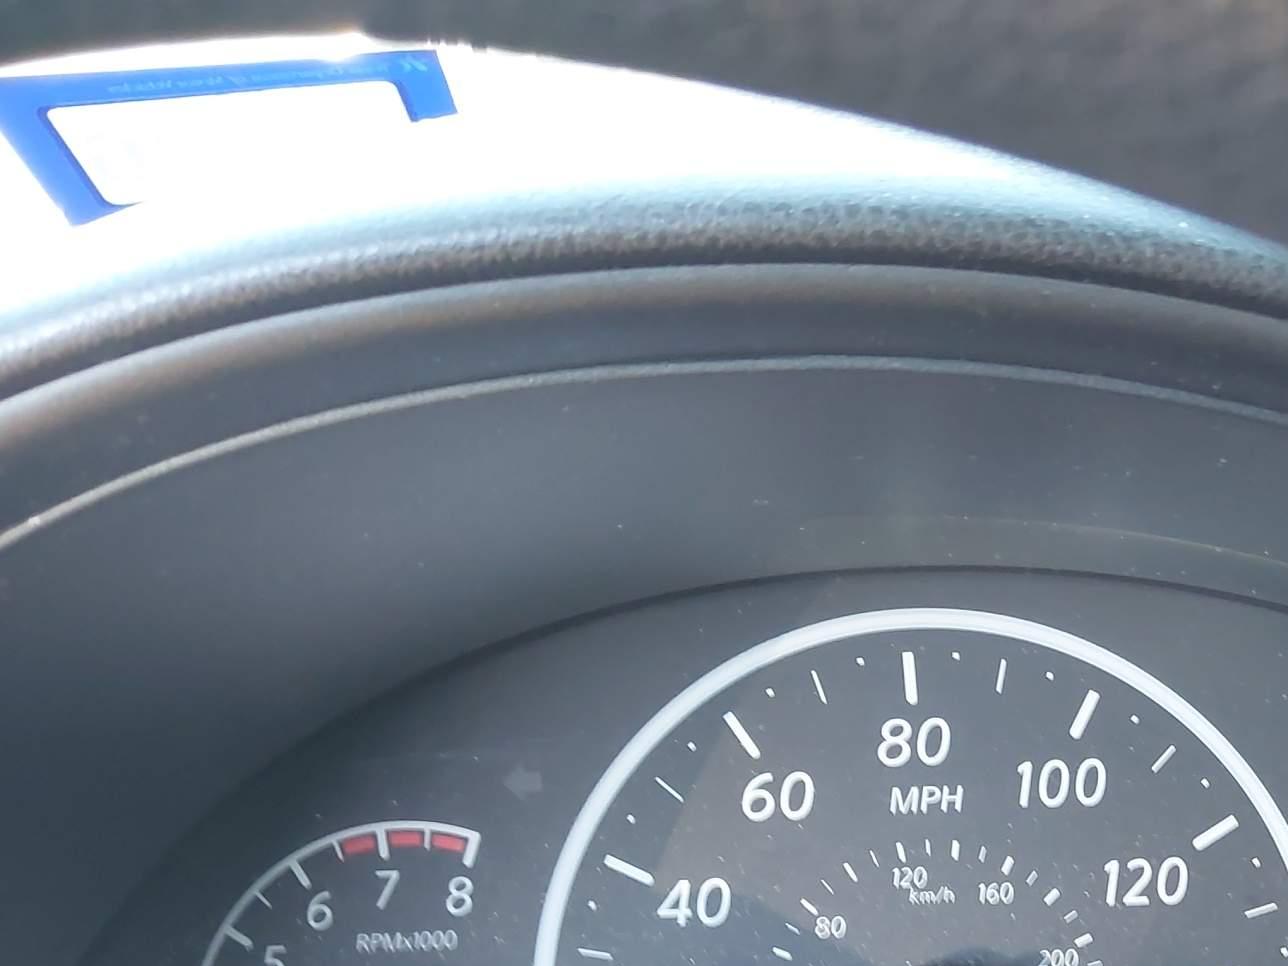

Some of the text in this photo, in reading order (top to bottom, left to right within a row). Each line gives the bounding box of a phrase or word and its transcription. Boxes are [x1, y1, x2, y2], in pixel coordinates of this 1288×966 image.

[877, 716, 952, 768] 80
[741, 771, 815, 822] 60
[889, 785, 964, 816] MPH
[1016, 757, 1106, 809] 100
[375, 869, 399, 910] 7
[446, 876, 473, 917] 8
[892, 866, 928, 889] 120
[909, 886, 955, 905] km/h
[978, 882, 1015, 905] 160
[1103, 855, 1188, 908] 120
[307, 890, 333, 931] 6
[656, 876, 731, 928] 40
[356, 930, 458, 954] RPMx1000
[815, 915, 846, 939] 80
